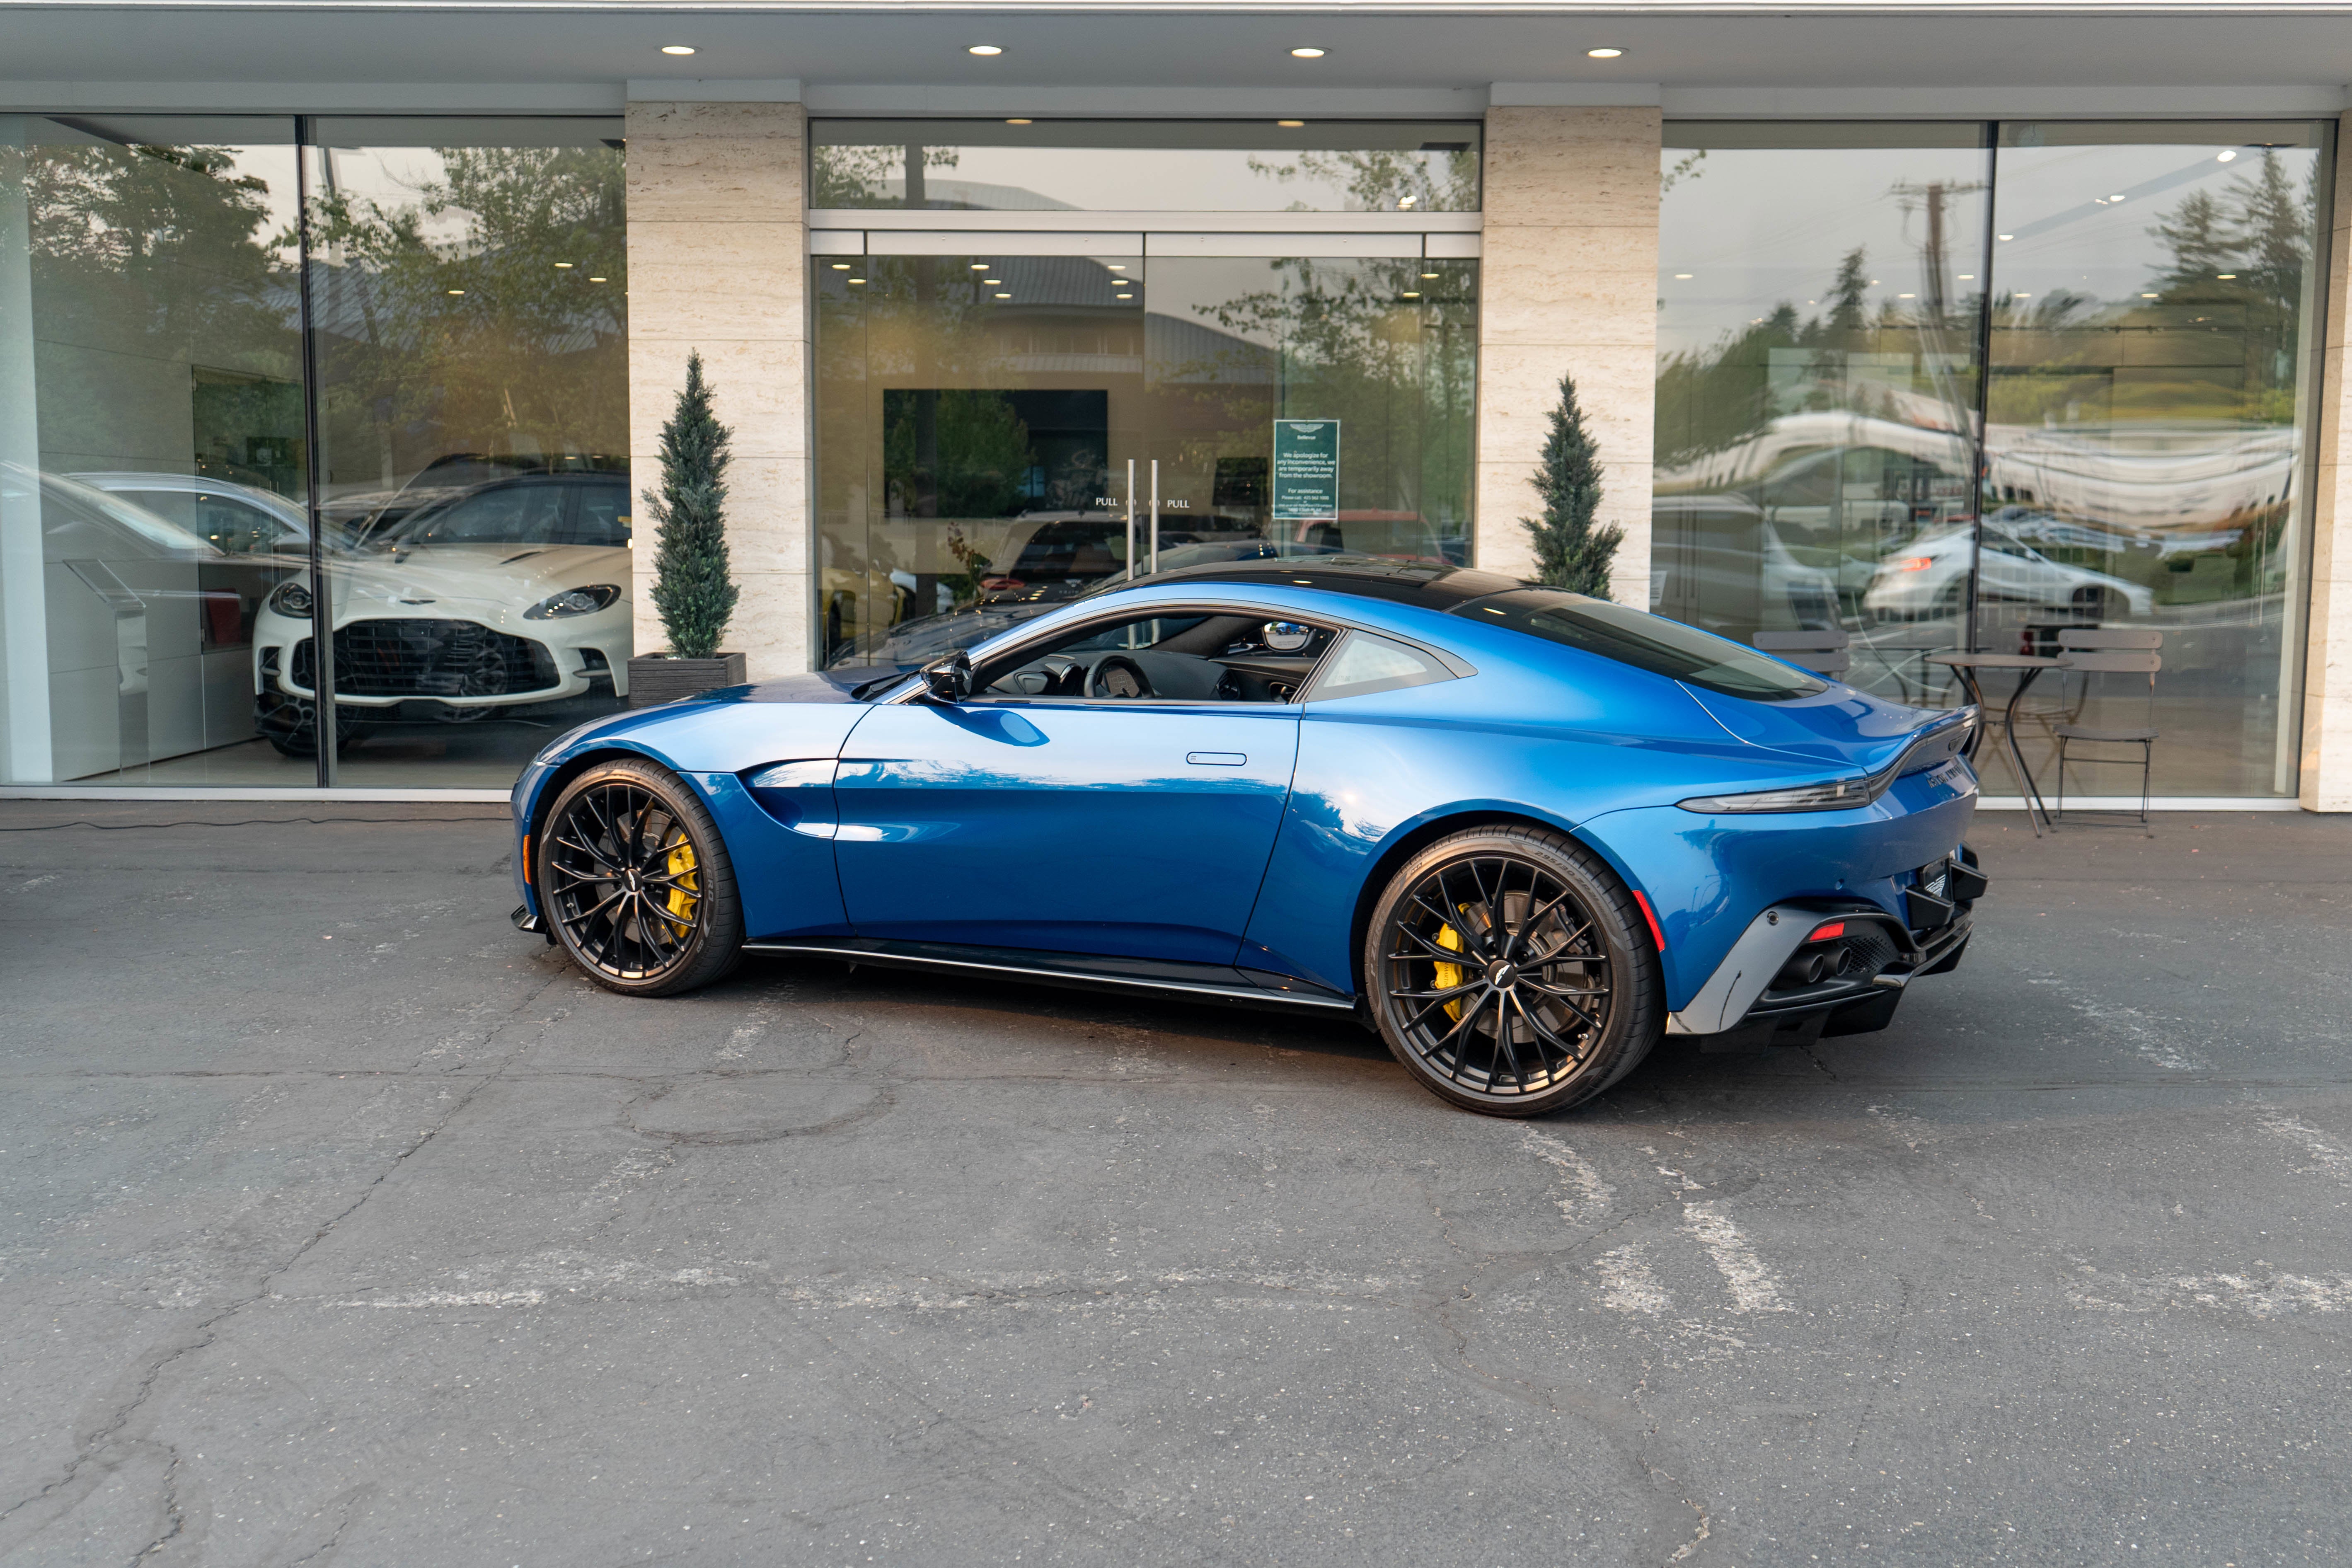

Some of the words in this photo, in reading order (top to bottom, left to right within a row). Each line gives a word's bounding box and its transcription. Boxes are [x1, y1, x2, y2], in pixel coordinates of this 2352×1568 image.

[1096, 497, 1118, 506] PULL
[1167, 500, 1190, 508] PULL
[1534, 851, 1575, 876] 295/30
